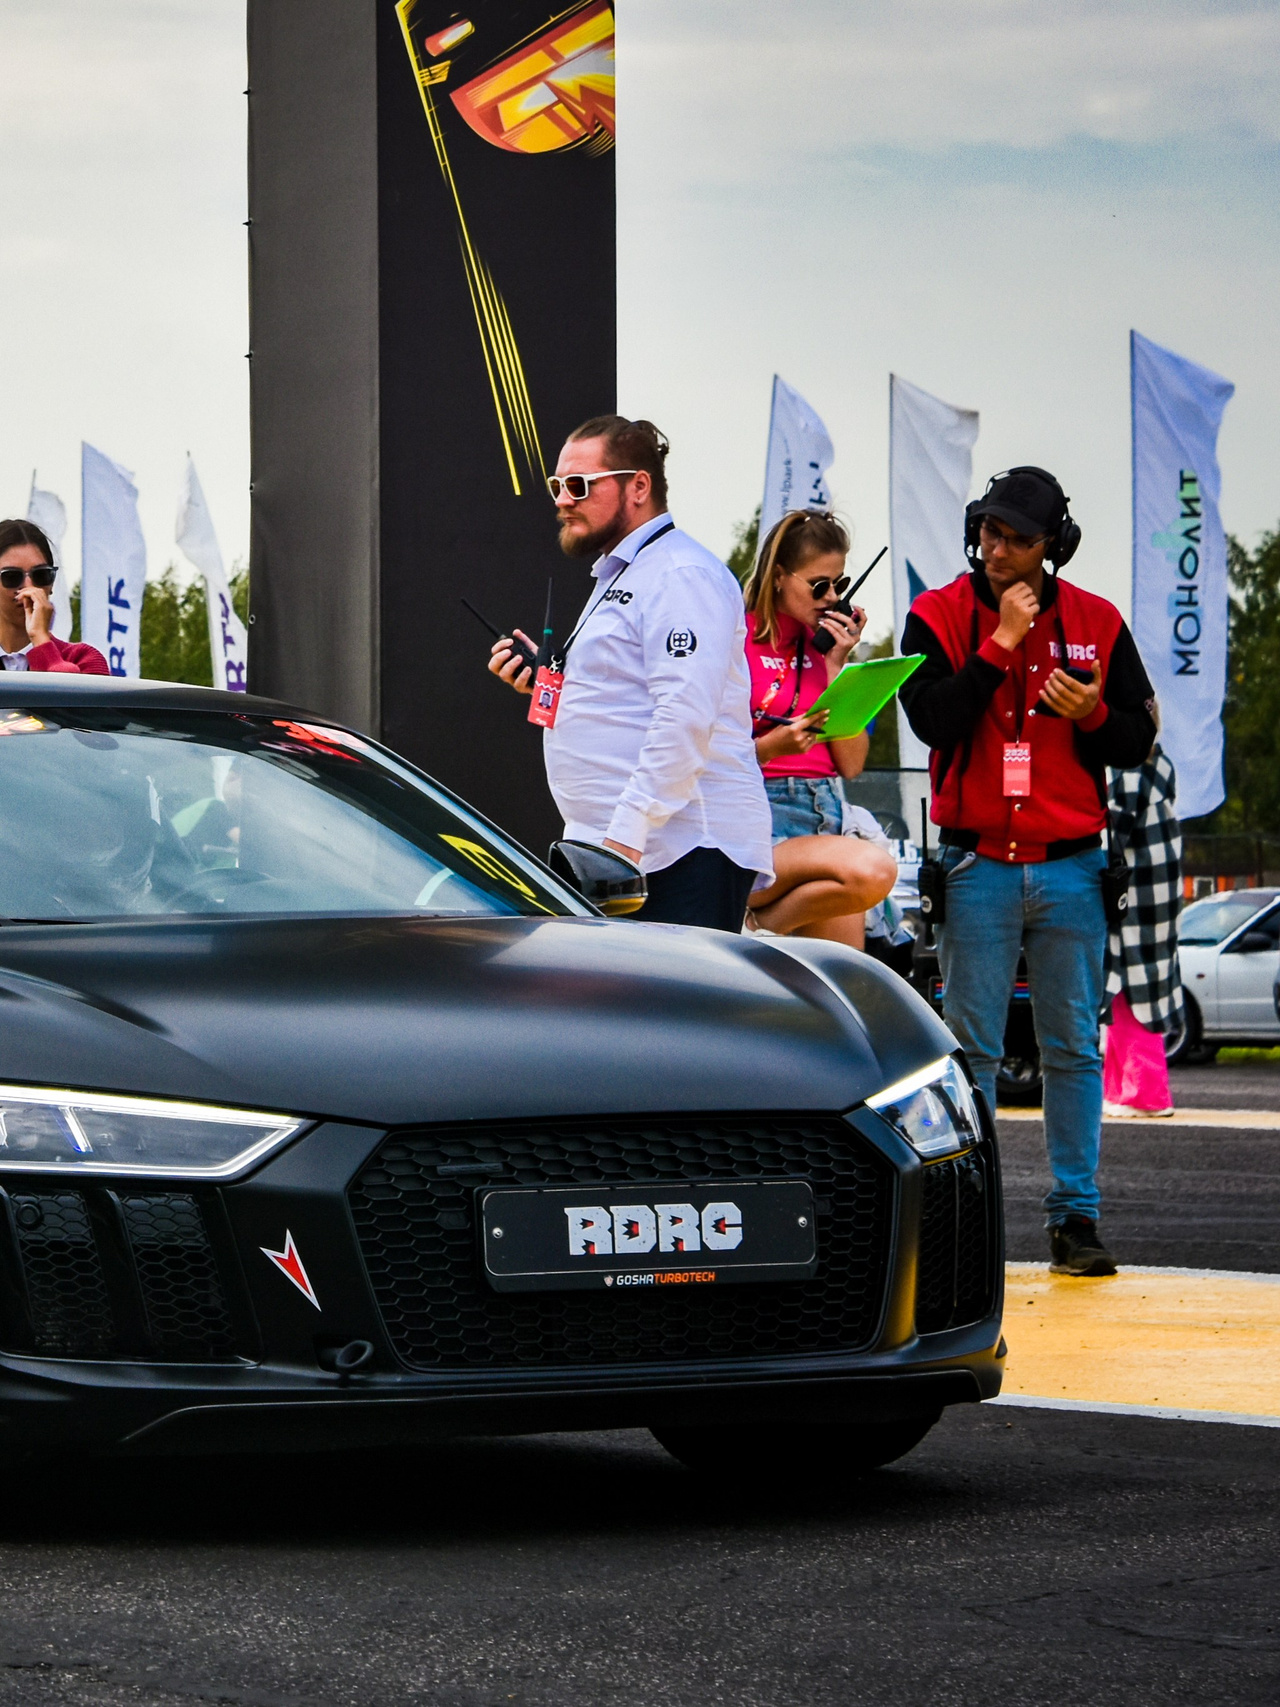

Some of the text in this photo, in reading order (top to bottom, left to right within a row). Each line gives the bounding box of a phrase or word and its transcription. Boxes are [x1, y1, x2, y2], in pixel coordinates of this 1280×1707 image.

[1172, 469, 1202, 676] МОНОЛИТ
[603, 589, 634, 605] DRC
[564, 1201, 744, 1256] RDRC
[616, 1271, 716, 1287] GOSHATURBOTECH
